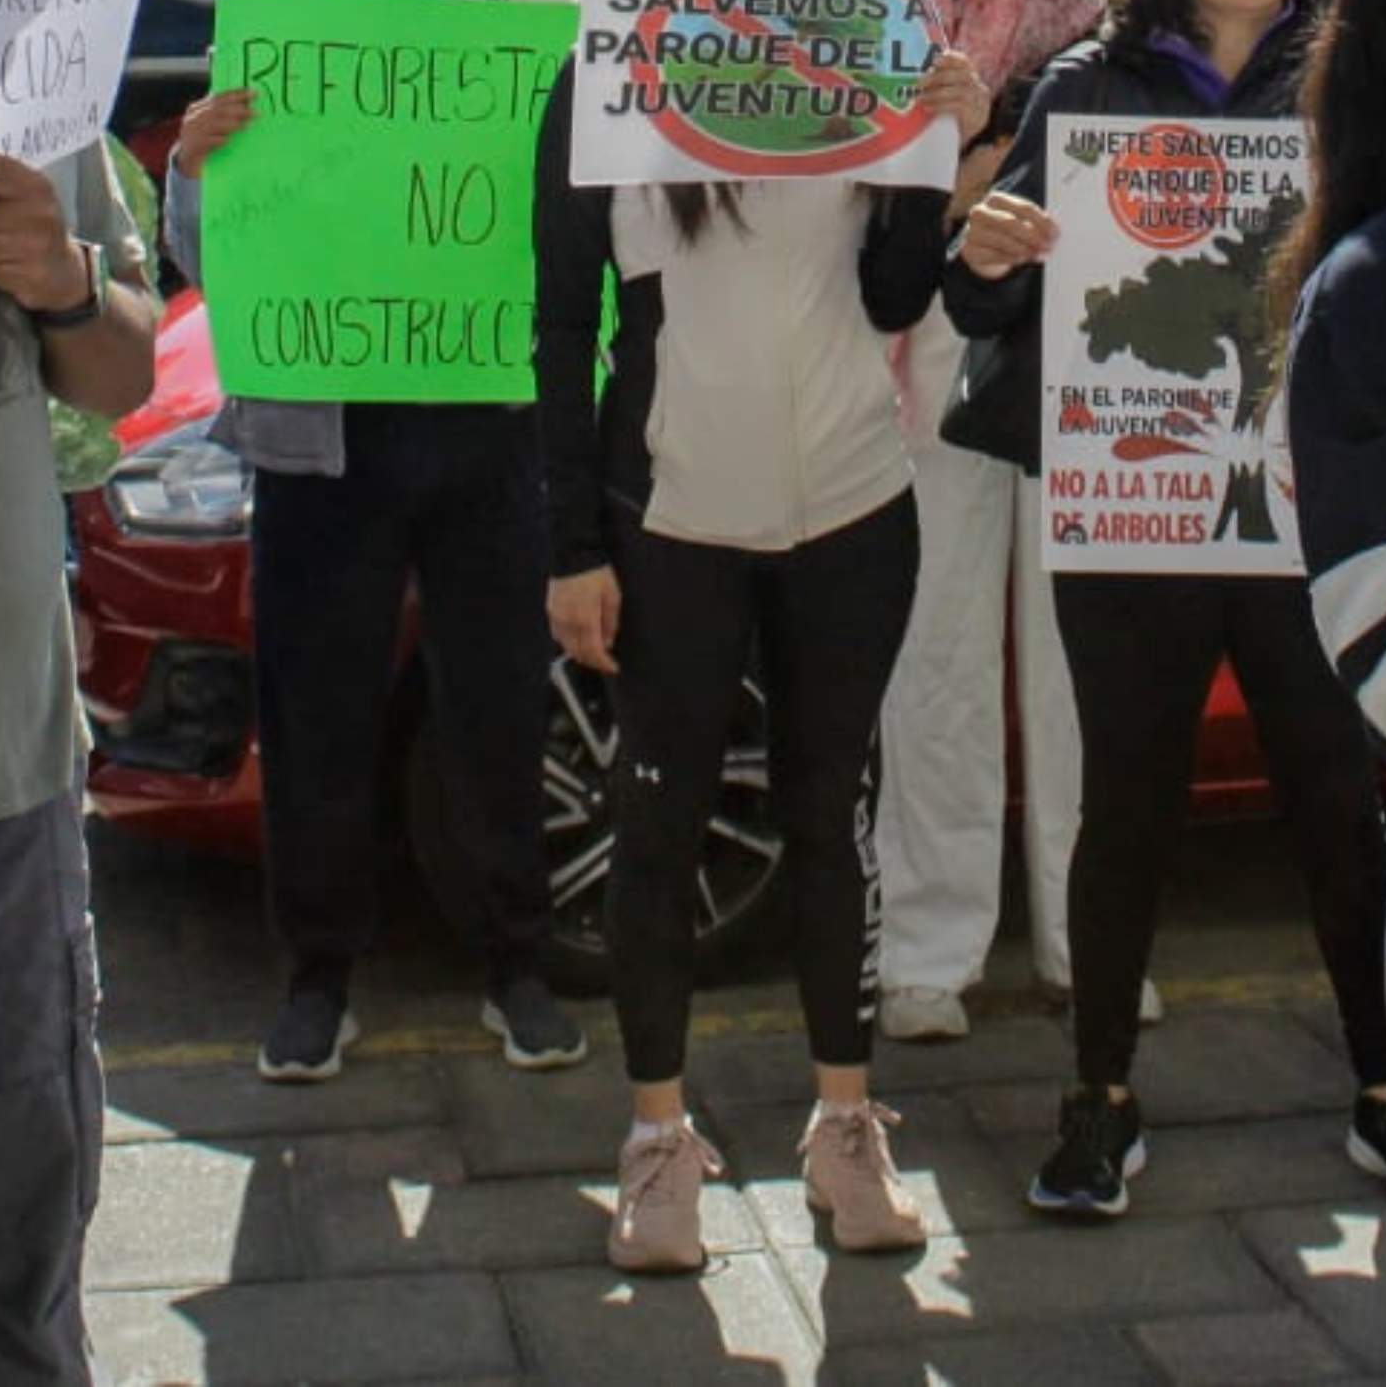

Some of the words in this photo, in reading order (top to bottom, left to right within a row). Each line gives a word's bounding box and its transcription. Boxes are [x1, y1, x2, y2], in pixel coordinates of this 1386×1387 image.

[585, 29, 805, 70] PARQUE
[809, 36, 875, 73] DE
[242, 37, 561, 128] REFORESTA
[603, 80, 880, 119] JUVENTUD
[1162, 132, 1300, 161] SALVEMOS
[1113, 168, 1218, 194] PARQUE
[1222, 169, 1256, 194] DE
[1262, 169, 1294, 195] LA
[406, 161, 498, 248] NO
[1061, 386, 1086, 407] EN
[1092, 387, 1115, 408] EL
[1209, 389, 1233, 410] DE
[1049, 469, 1086, 500] NO
[1093, 470, 1110, 501] A
[1116, 471, 1146, 502] LA
[1153, 471, 1215, 503] TALA
[1091, 512, 1207, 545] ARBOLES
